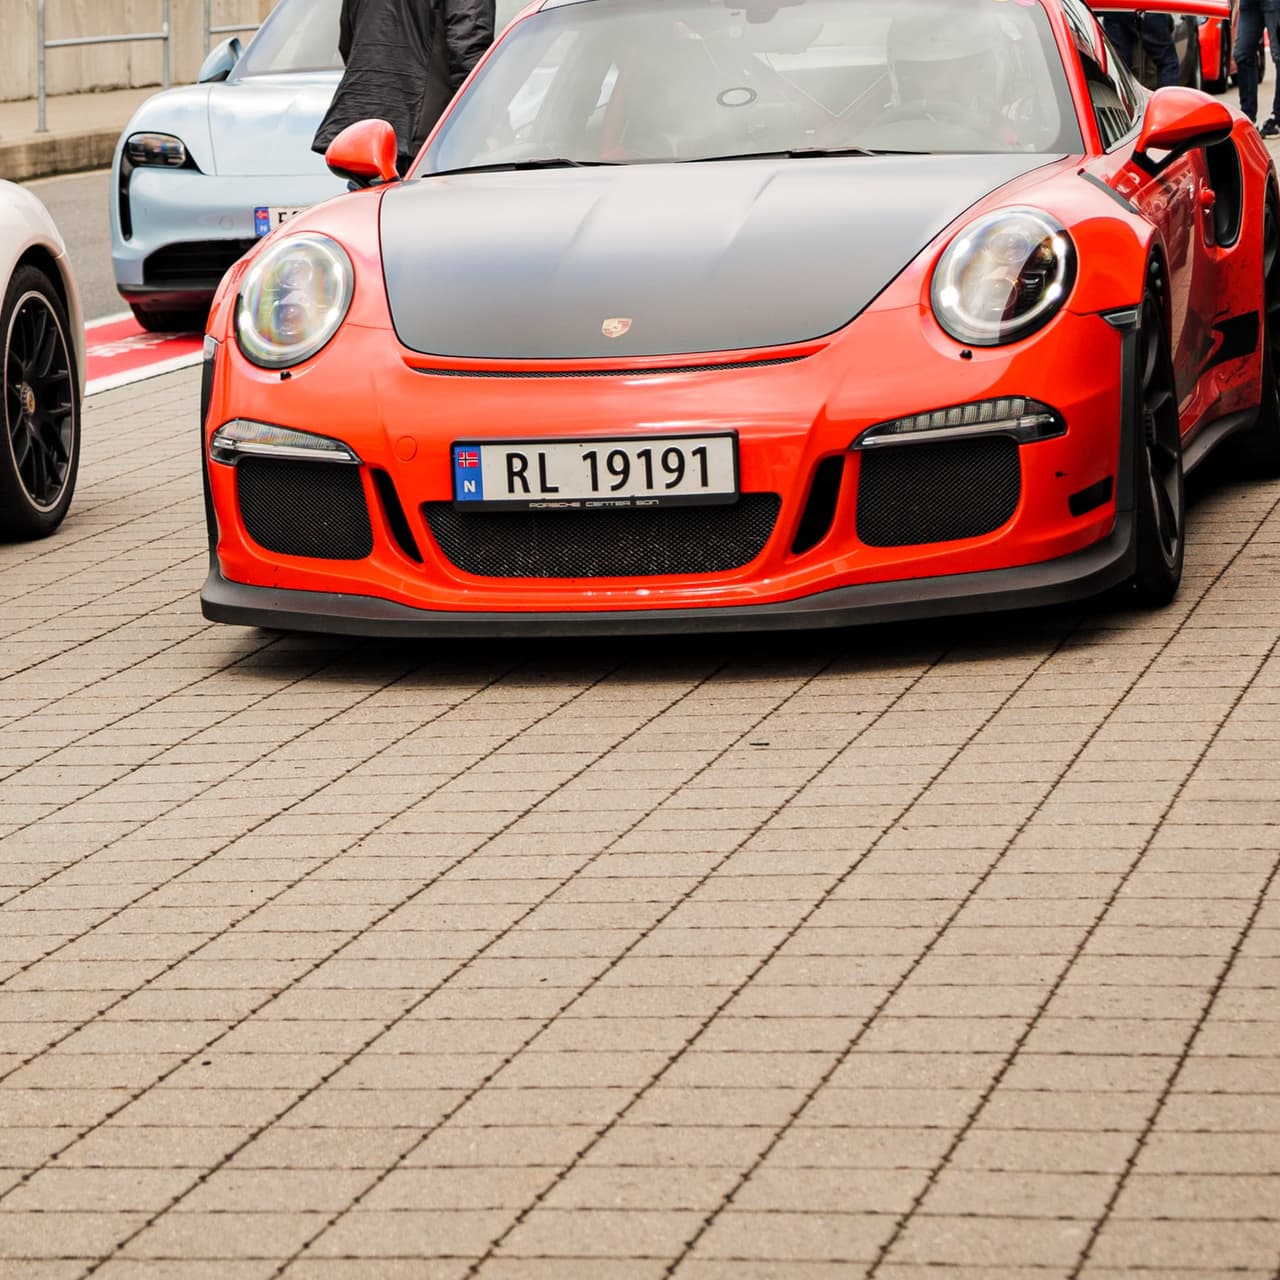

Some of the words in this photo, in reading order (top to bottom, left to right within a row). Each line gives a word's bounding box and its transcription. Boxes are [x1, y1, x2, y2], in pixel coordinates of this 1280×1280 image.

[505, 452, 560, 494] RL
[582, 445, 710, 492] 19191
[463, 480, 476, 493] N
